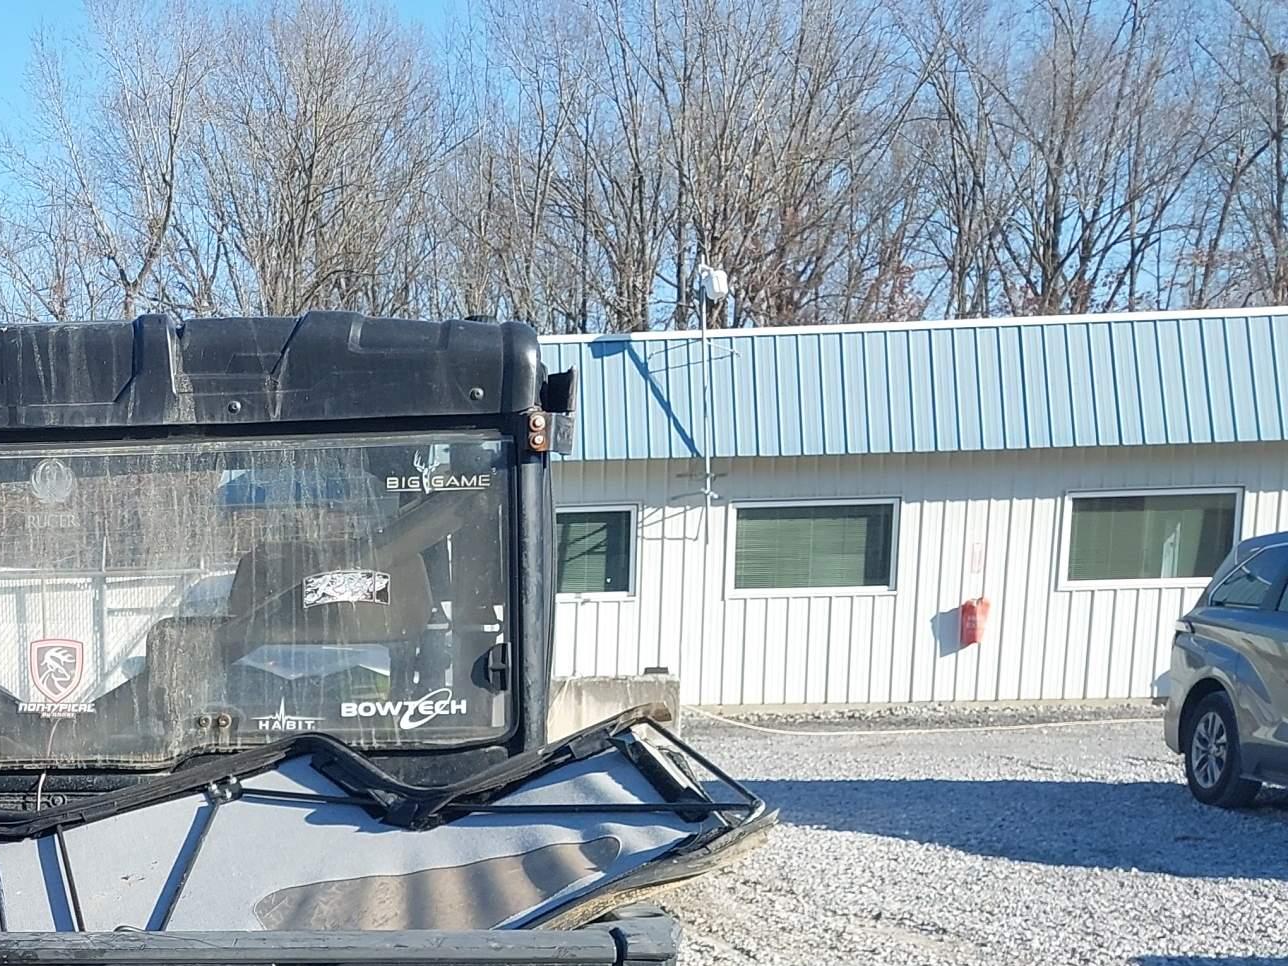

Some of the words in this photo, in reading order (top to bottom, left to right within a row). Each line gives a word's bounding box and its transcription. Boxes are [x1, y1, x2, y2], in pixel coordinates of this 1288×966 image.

[386, 476, 420, 488] BIG
[431, 474, 491, 487] GAME
[341, 700, 467, 717] BOWTECH
